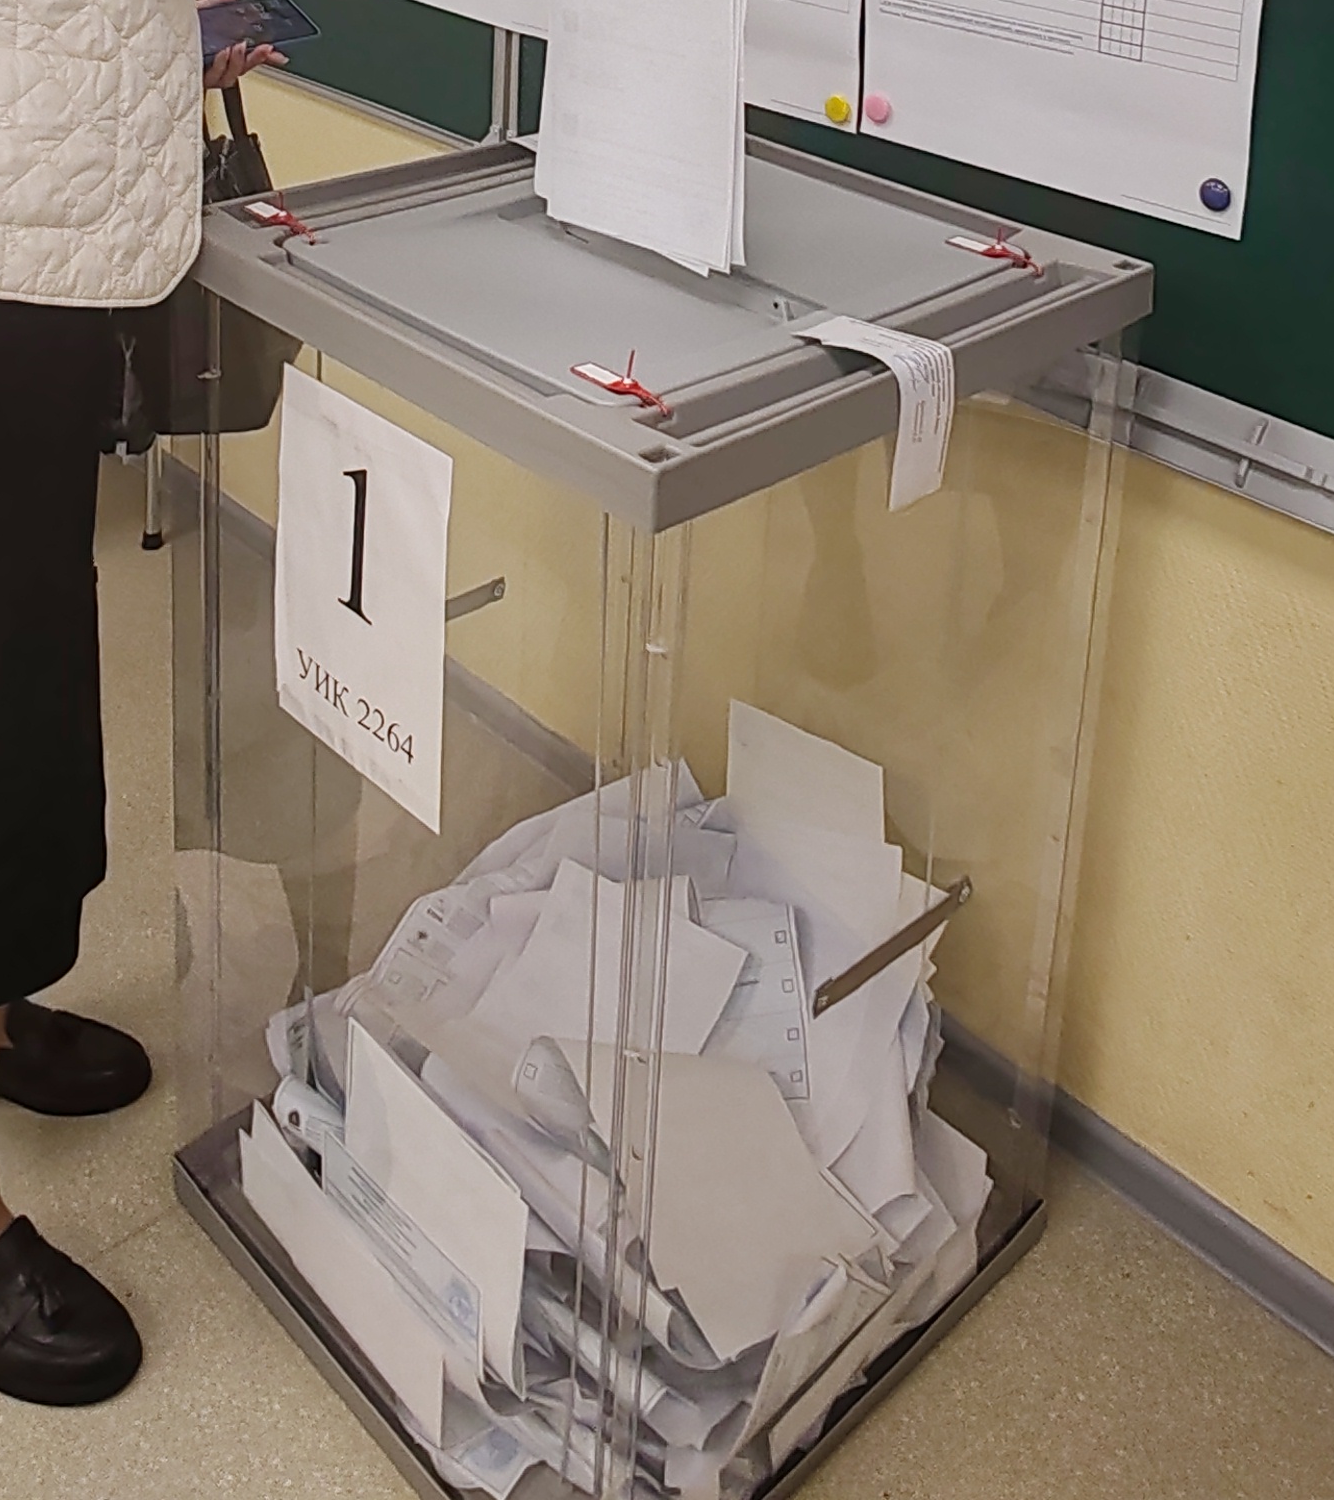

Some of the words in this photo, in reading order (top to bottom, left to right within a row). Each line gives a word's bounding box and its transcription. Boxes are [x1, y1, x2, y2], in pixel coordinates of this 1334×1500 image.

[337, 467, 373, 627] 1
[295, 646, 350, 719] УИК
[356, 698, 416, 765] 2264
